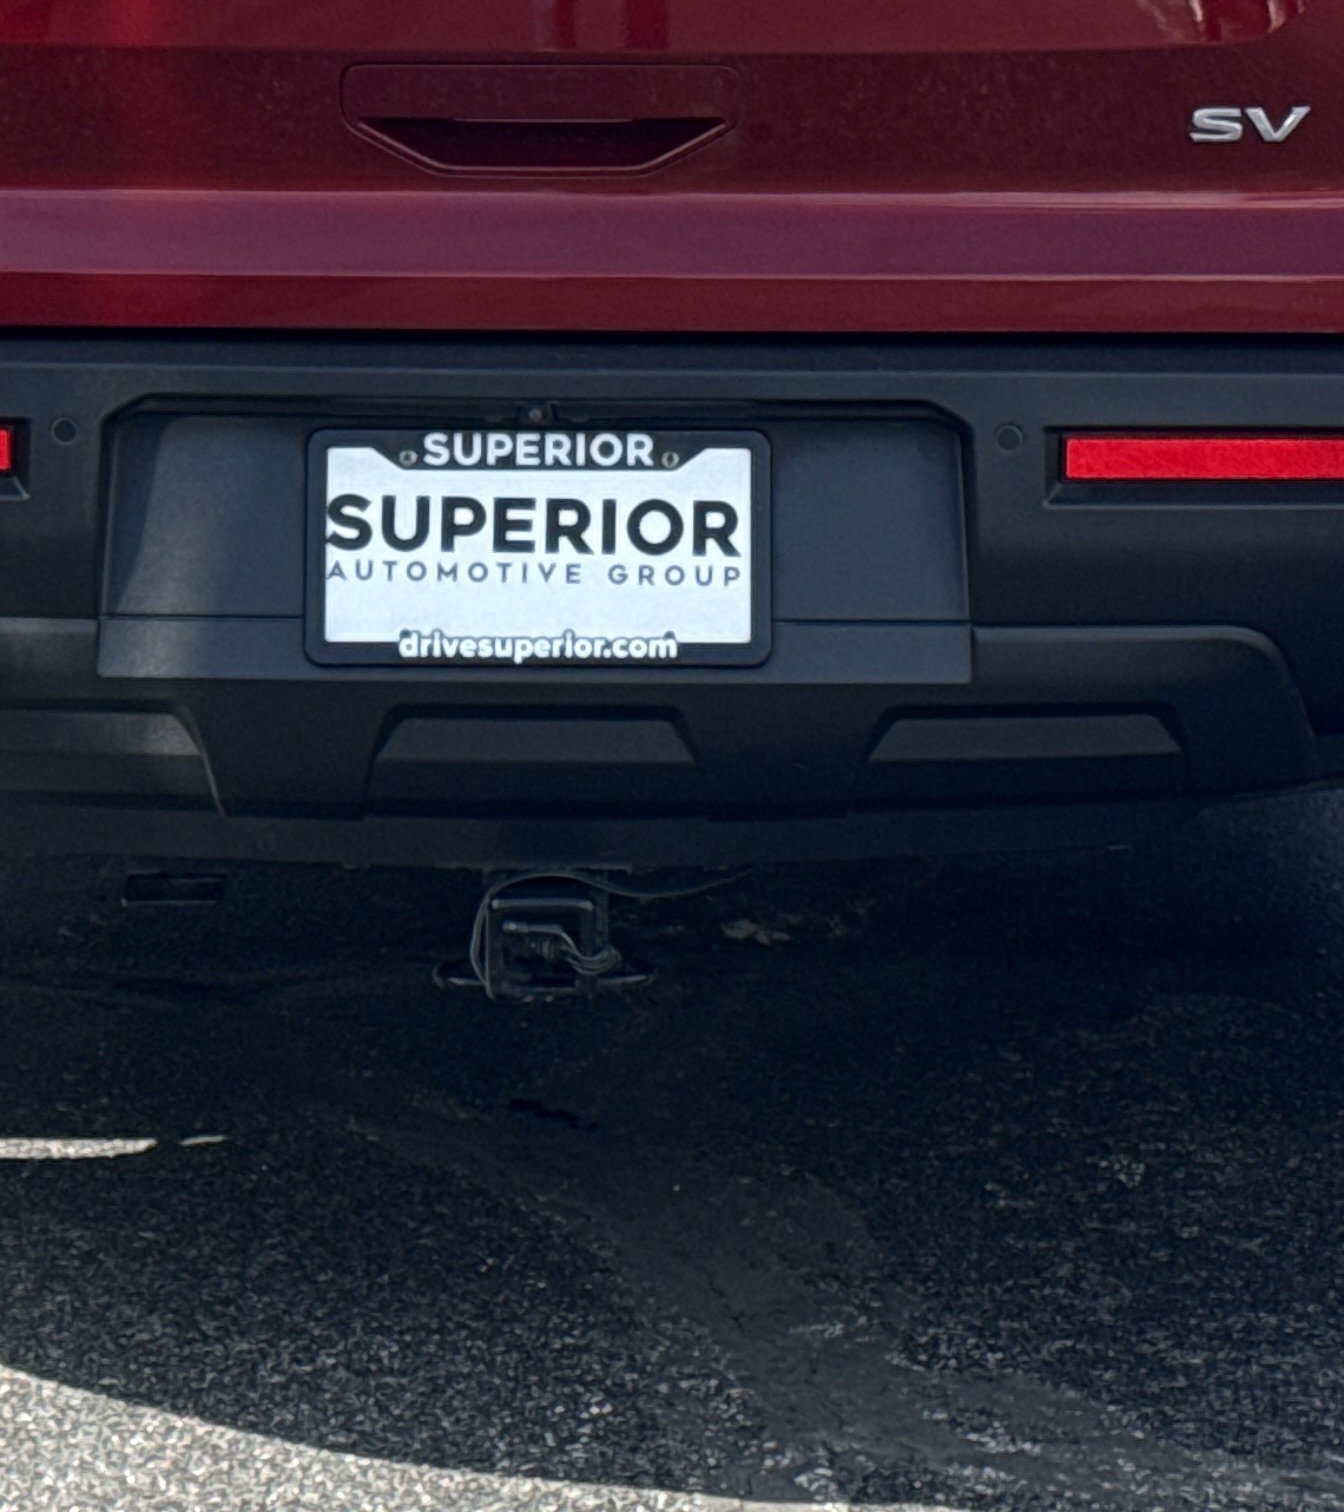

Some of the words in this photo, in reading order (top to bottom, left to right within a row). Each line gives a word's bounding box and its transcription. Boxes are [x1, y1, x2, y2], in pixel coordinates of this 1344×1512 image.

[1189, 105, 1312, 143] SV
[422, 432, 655, 468] SUPERIOR
[325, 493, 742, 558] SUPERIOR
[326, 559, 583, 585] AUTOMOTIVE
[607, 563, 742, 587] GROUP
[398, 630, 678, 664] drivesuperior.com
